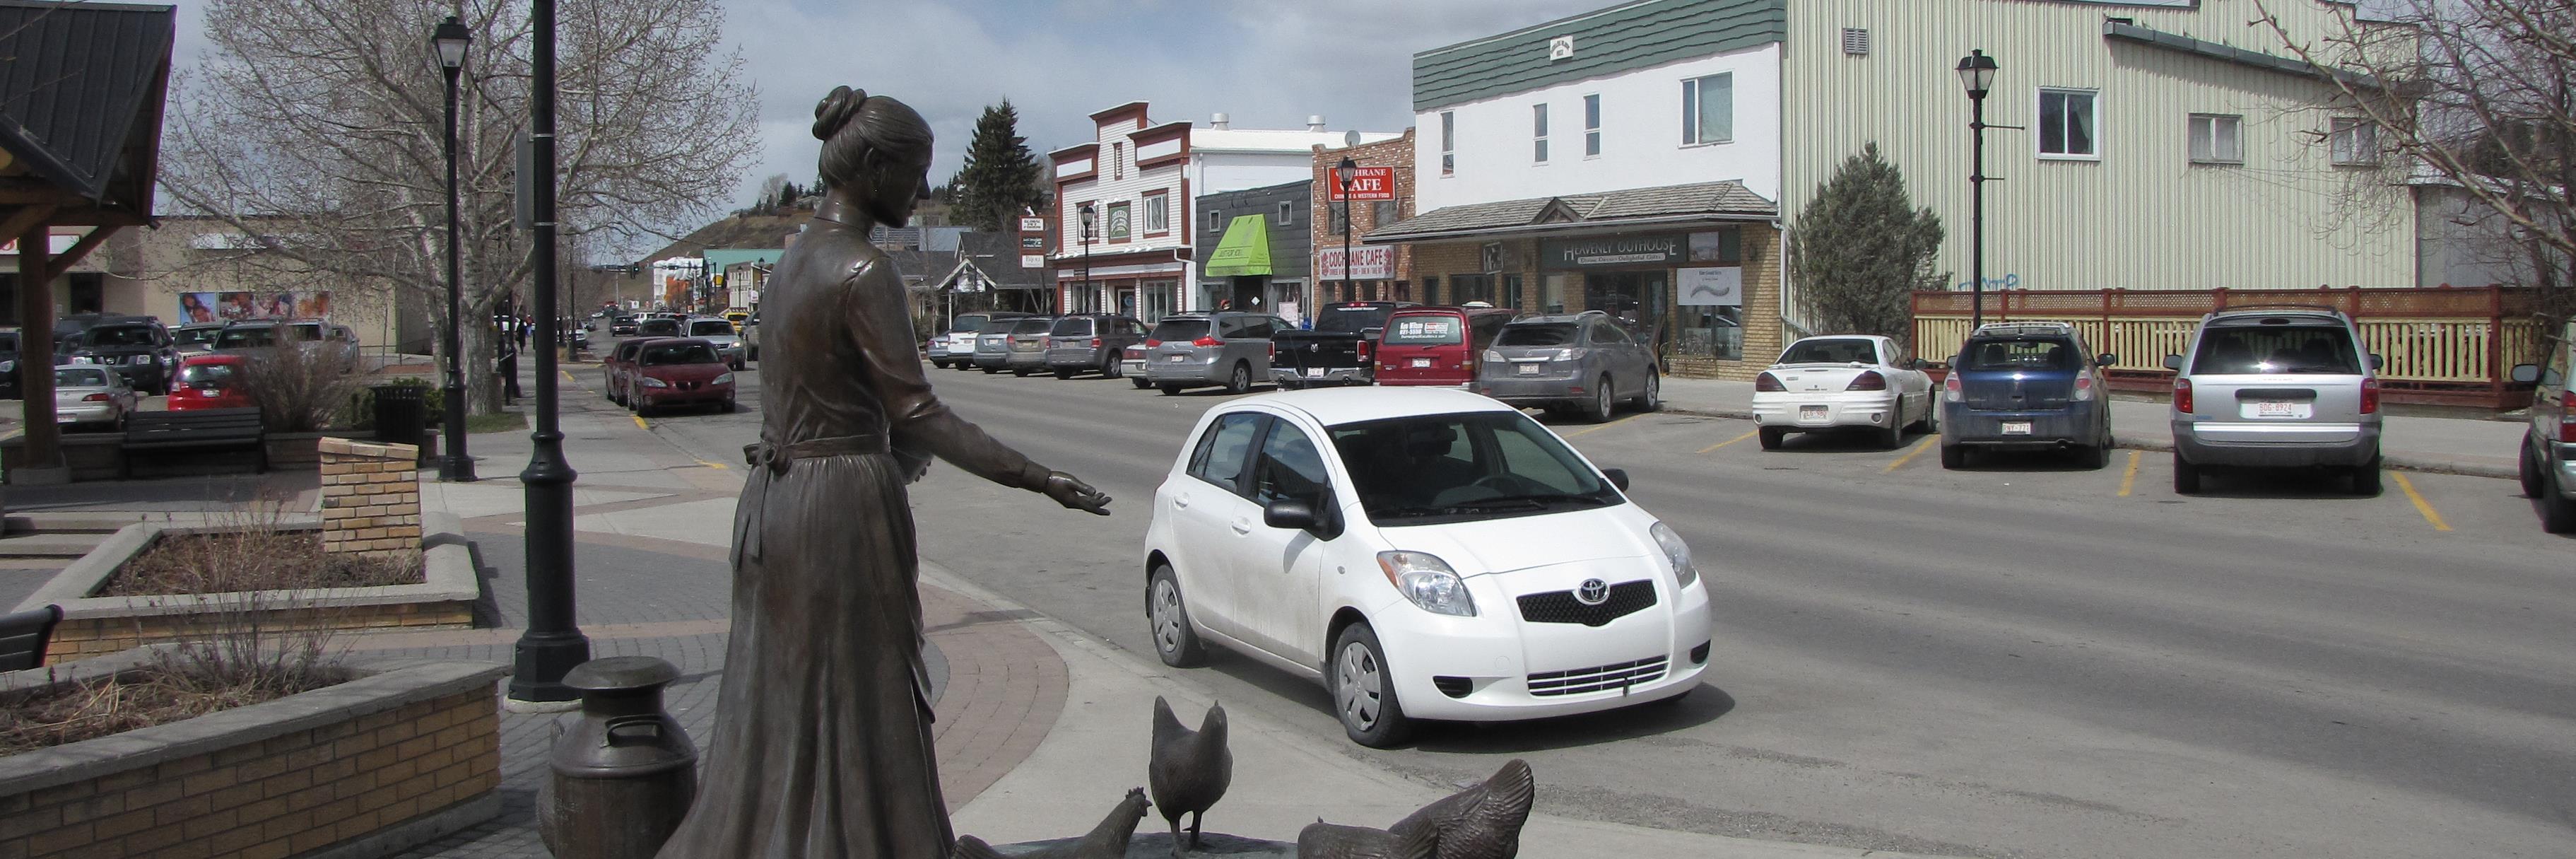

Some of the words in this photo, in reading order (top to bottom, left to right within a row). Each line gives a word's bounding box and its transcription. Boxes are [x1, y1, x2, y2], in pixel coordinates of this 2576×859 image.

[1329, 250, 1364, 267] COCHANE
[1365, 249, 1383, 265] CAFE
[1564, 242, 1611, 261] HEAVENLY
[1618, 238, 1677, 256] OUTHOUSE
